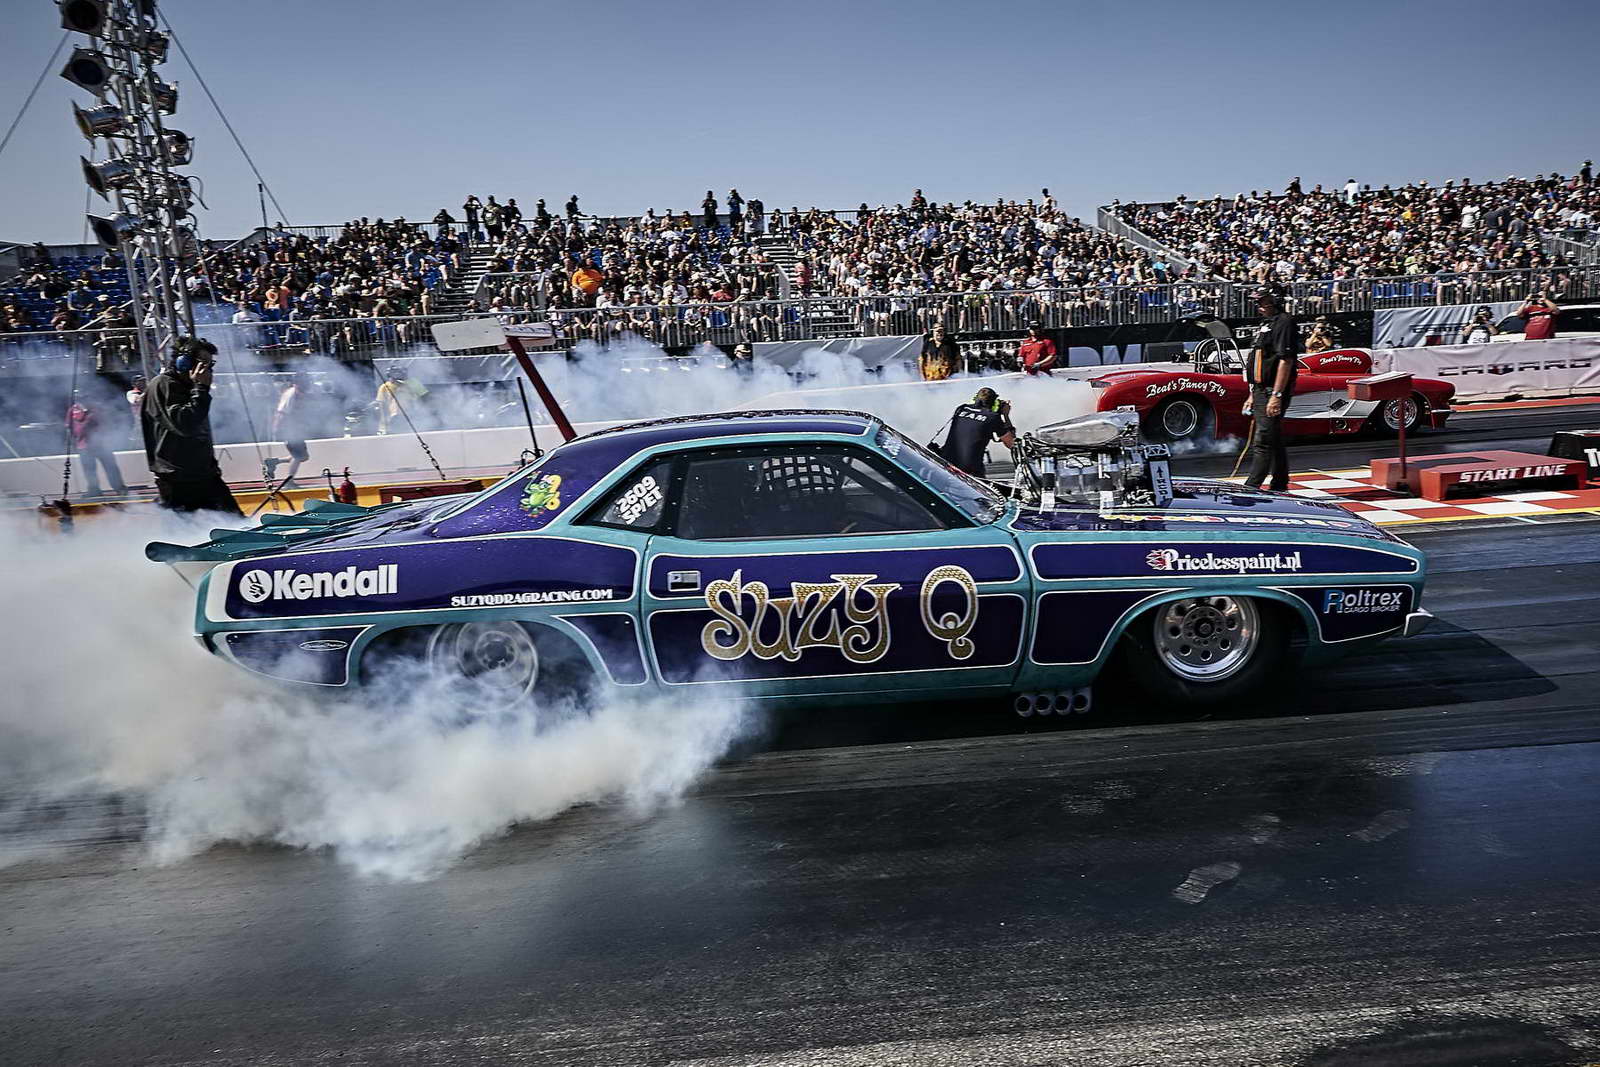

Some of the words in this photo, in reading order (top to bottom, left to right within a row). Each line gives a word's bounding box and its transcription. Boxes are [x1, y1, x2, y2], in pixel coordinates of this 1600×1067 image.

[1146, 380, 1178, 398] Beat's
[1178, 377, 1208, 392] Fancy
[1209, 380, 1226, 397] Fly
[1458, 467, 1520, 483] START
[1522, 464, 1568, 478] LINE
[616, 475, 656, 513] 2609
[619, 486, 663, 525] SP/ET
[1161, 548, 1302, 574] Pricelesspaint.nl
[273, 564, 398, 600] Kendall
[451, 588, 613, 607] SUZYQDRAGRACING.COM
[1323, 589, 1404, 614] Roltrex
[1344, 606, 1369, 614] CARGO
[1370, 605, 1400, 613] BROKER
[920, 564, 979, 660] Q
